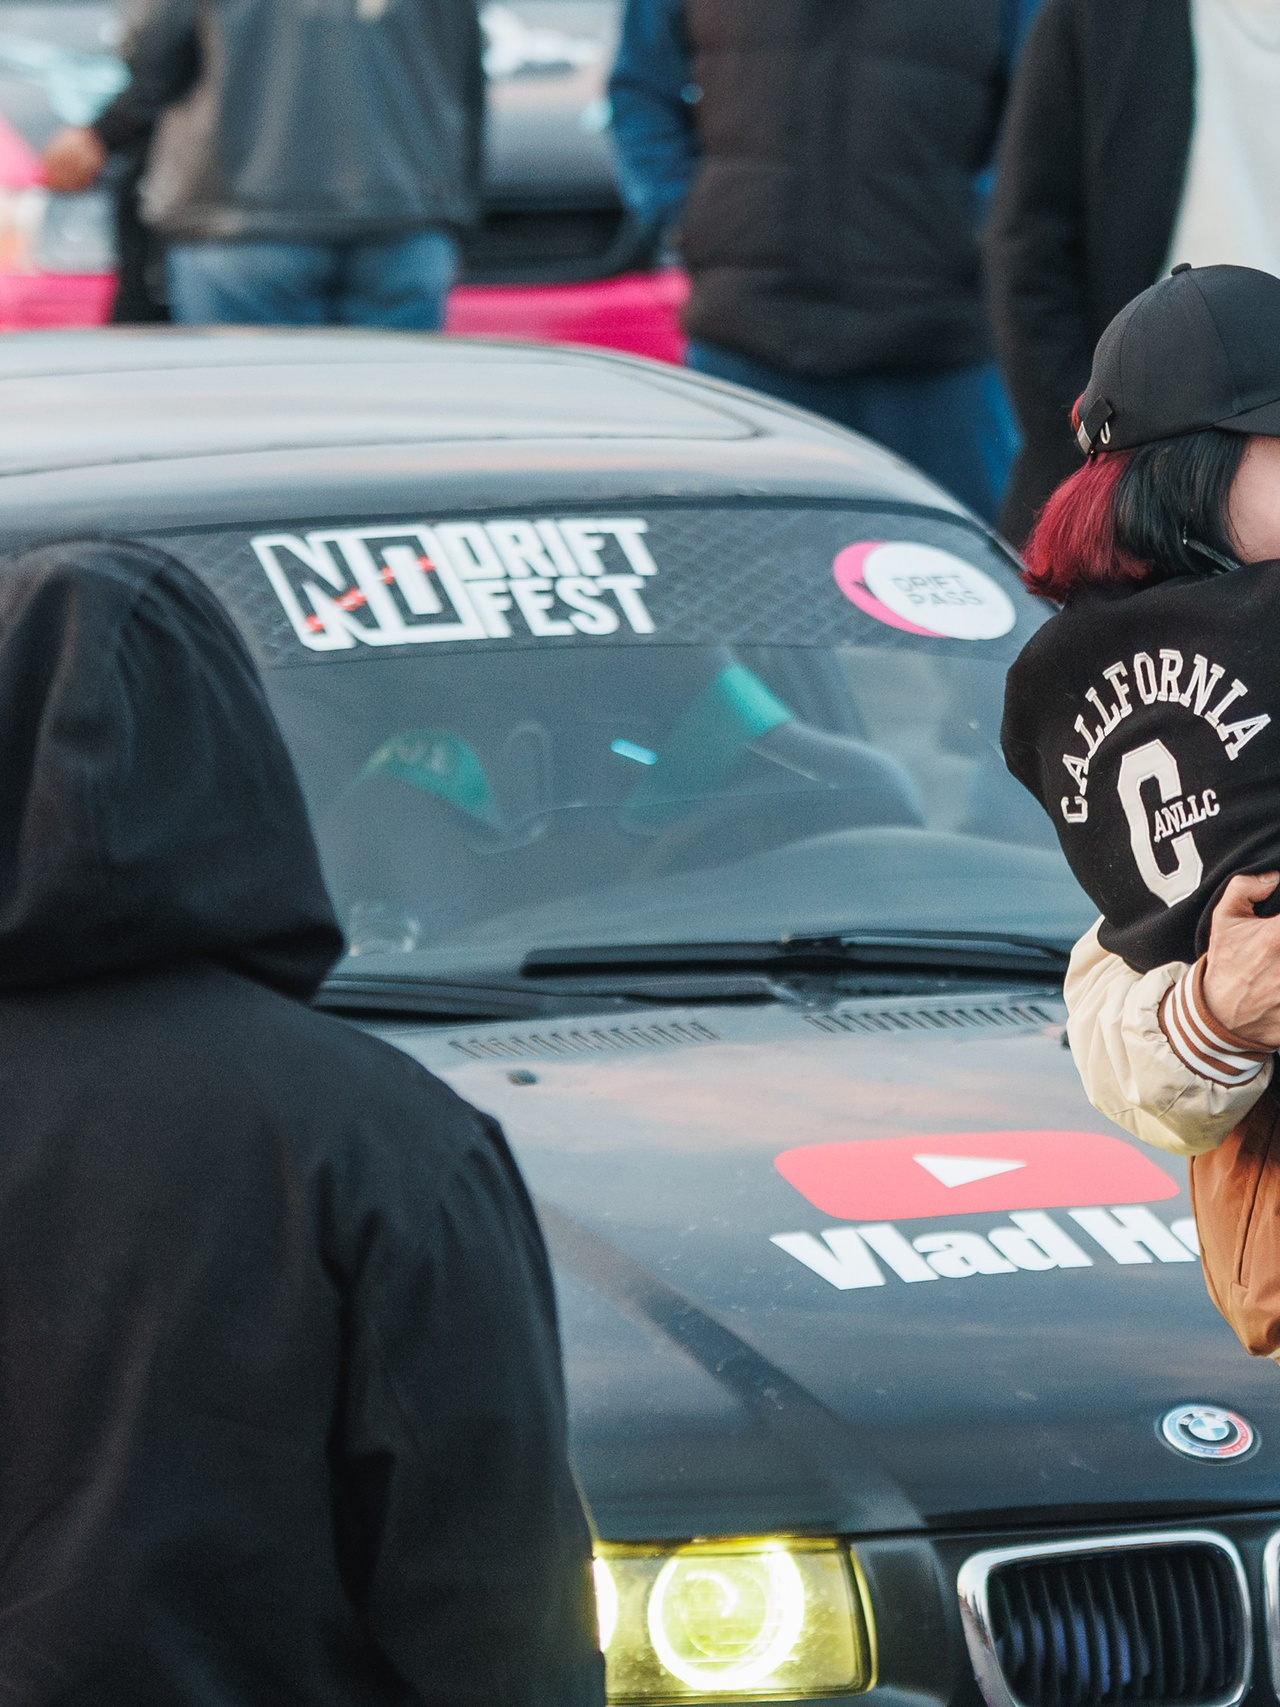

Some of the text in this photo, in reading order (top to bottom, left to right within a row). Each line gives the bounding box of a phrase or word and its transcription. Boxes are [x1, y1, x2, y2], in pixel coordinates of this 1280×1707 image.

[434, 518, 659, 578] DRIFT
[464, 574, 656, 638] FEST
[892, 575, 965, 592] DRIFT
[908, 590, 984, 607] PASS
[1116, 738, 1204, 908] C
[1153, 789, 1220, 843] ANLLC
[769, 1210, 1094, 1291] Vlad
